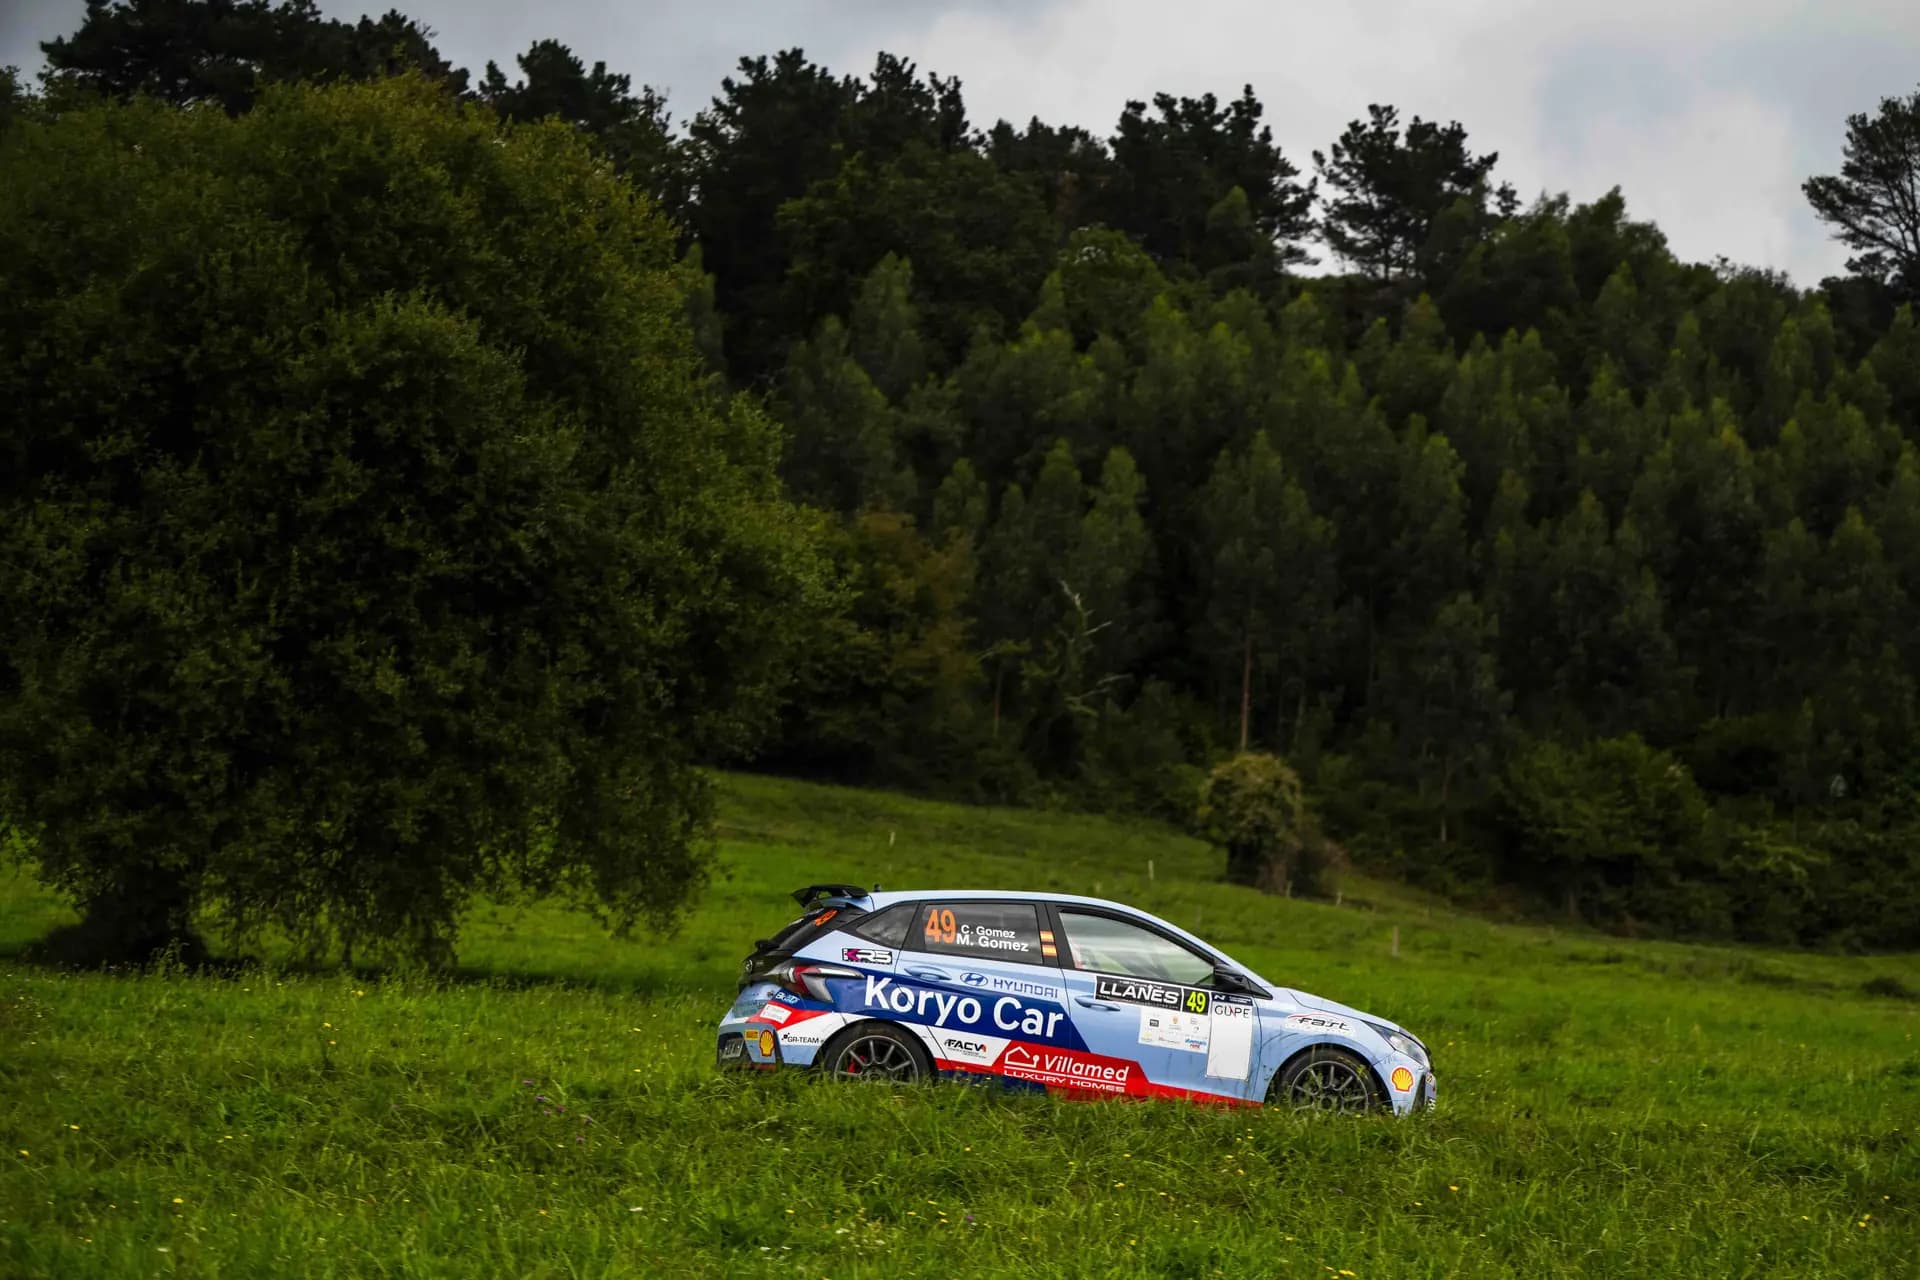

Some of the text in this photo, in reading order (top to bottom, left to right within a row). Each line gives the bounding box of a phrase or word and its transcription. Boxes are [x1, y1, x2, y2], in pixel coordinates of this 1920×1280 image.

[925, 908, 956, 943] 49
[961, 925, 1016, 938] C. Gomez
[956, 933, 1029, 952] M. Gomez
[993, 978, 1058, 999] HYUNDAI
[1100, 981, 1180, 1005] LLANES
[864, 975, 1064, 1038] Koryo Car
[1186, 991, 1206, 1013] 49
[1044, 1054, 1130, 1082] Villamed
[1003, 1070, 1126, 1093] LUXURY HOMES
